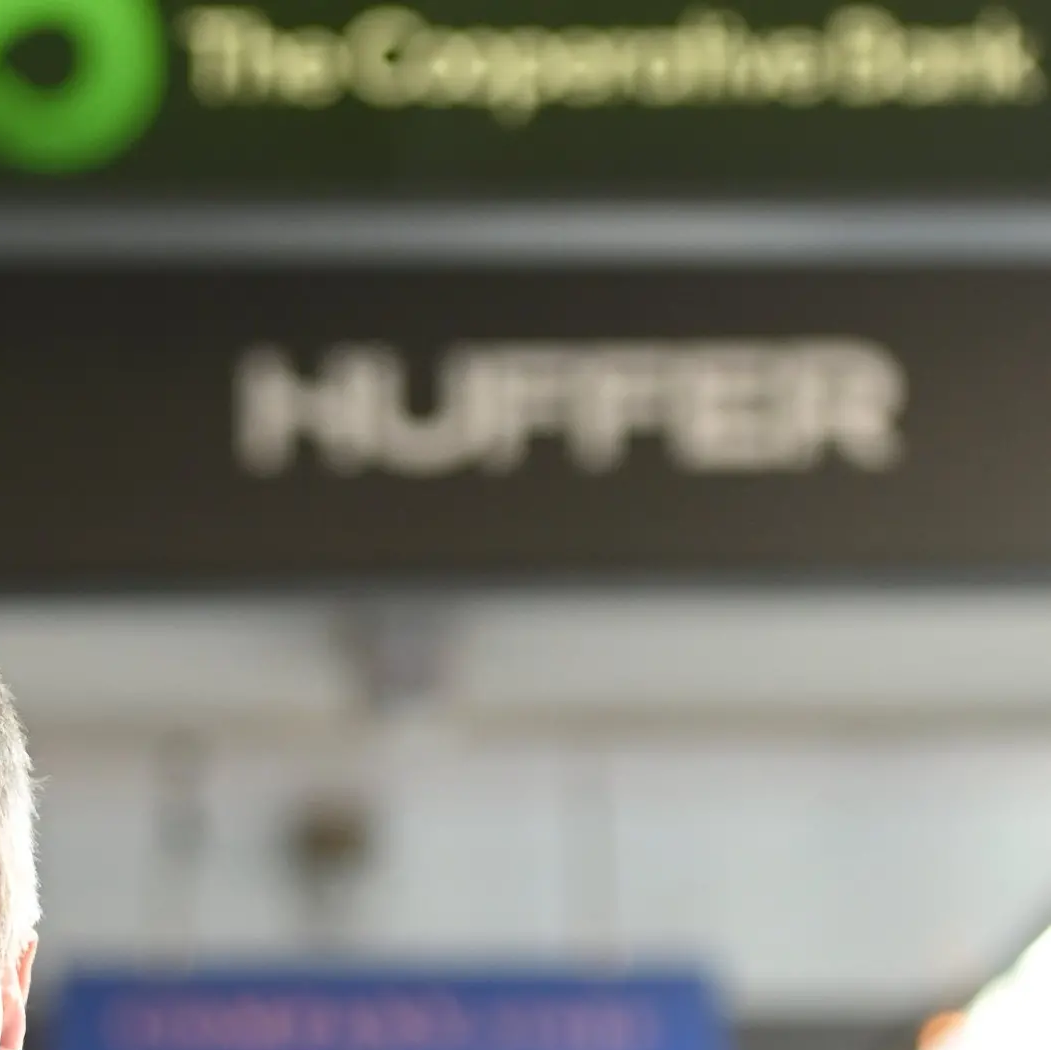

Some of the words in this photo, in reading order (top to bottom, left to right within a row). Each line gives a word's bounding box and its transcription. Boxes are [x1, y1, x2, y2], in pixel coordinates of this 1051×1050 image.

[184, 9, 344, 105] The
[824, 7, 1042, 108] Bank
[237, 337, 907, 472] HUFFER
